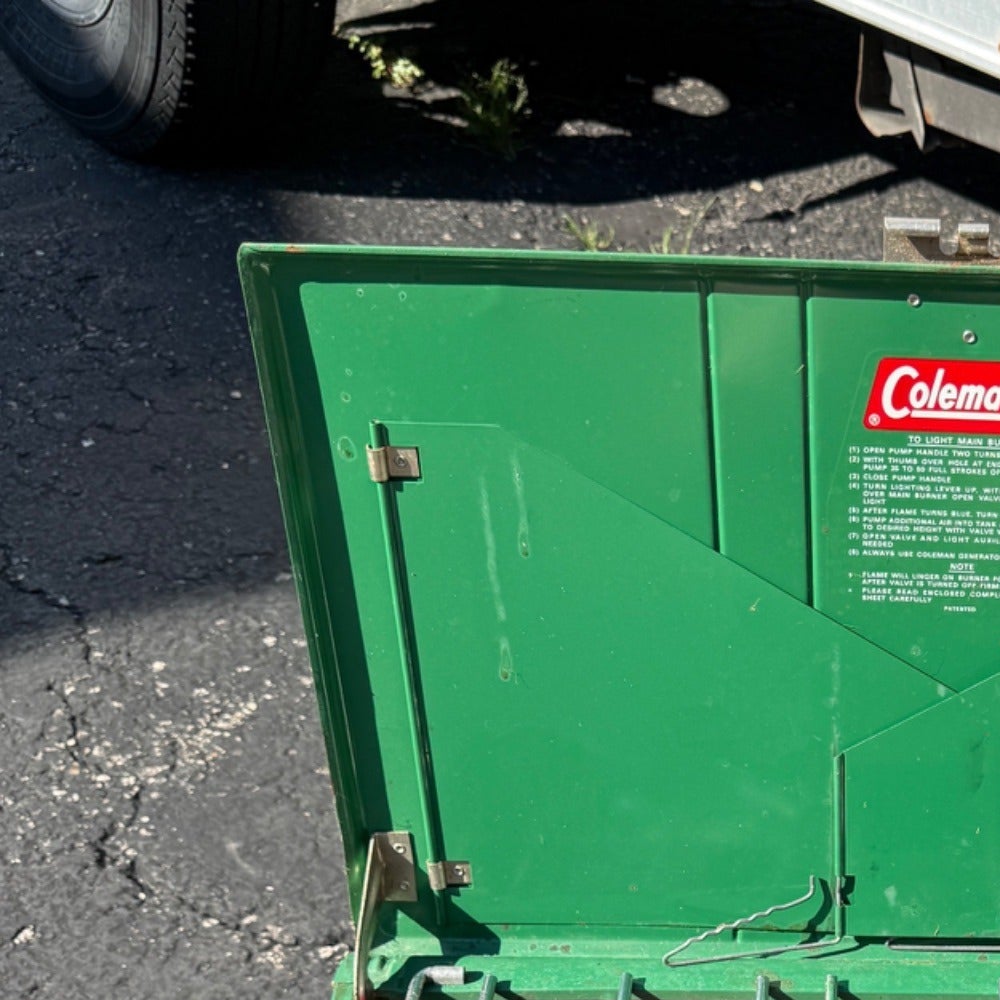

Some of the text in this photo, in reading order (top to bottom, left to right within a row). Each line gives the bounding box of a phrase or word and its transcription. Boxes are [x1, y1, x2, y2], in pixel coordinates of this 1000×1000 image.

[888, 457, 917, 465] THUMB
[950, 467, 986, 475] STROKES
[918, 475, 951, 483] HANDLE
[891, 484, 931, 492] LIGHTING
[934, 485, 961, 493] LEVER
[915, 492, 946, 500] BURNER
[862, 516, 886, 524] PUMP
[889, 517, 937, 525] ADDITIONAL
[877, 524, 909, 532] DESIRED
[916, 551, 955, 559] COLEMAN
[912, 573, 939, 581] LINGER
[889, 596, 931, 604] CAREFULLY
